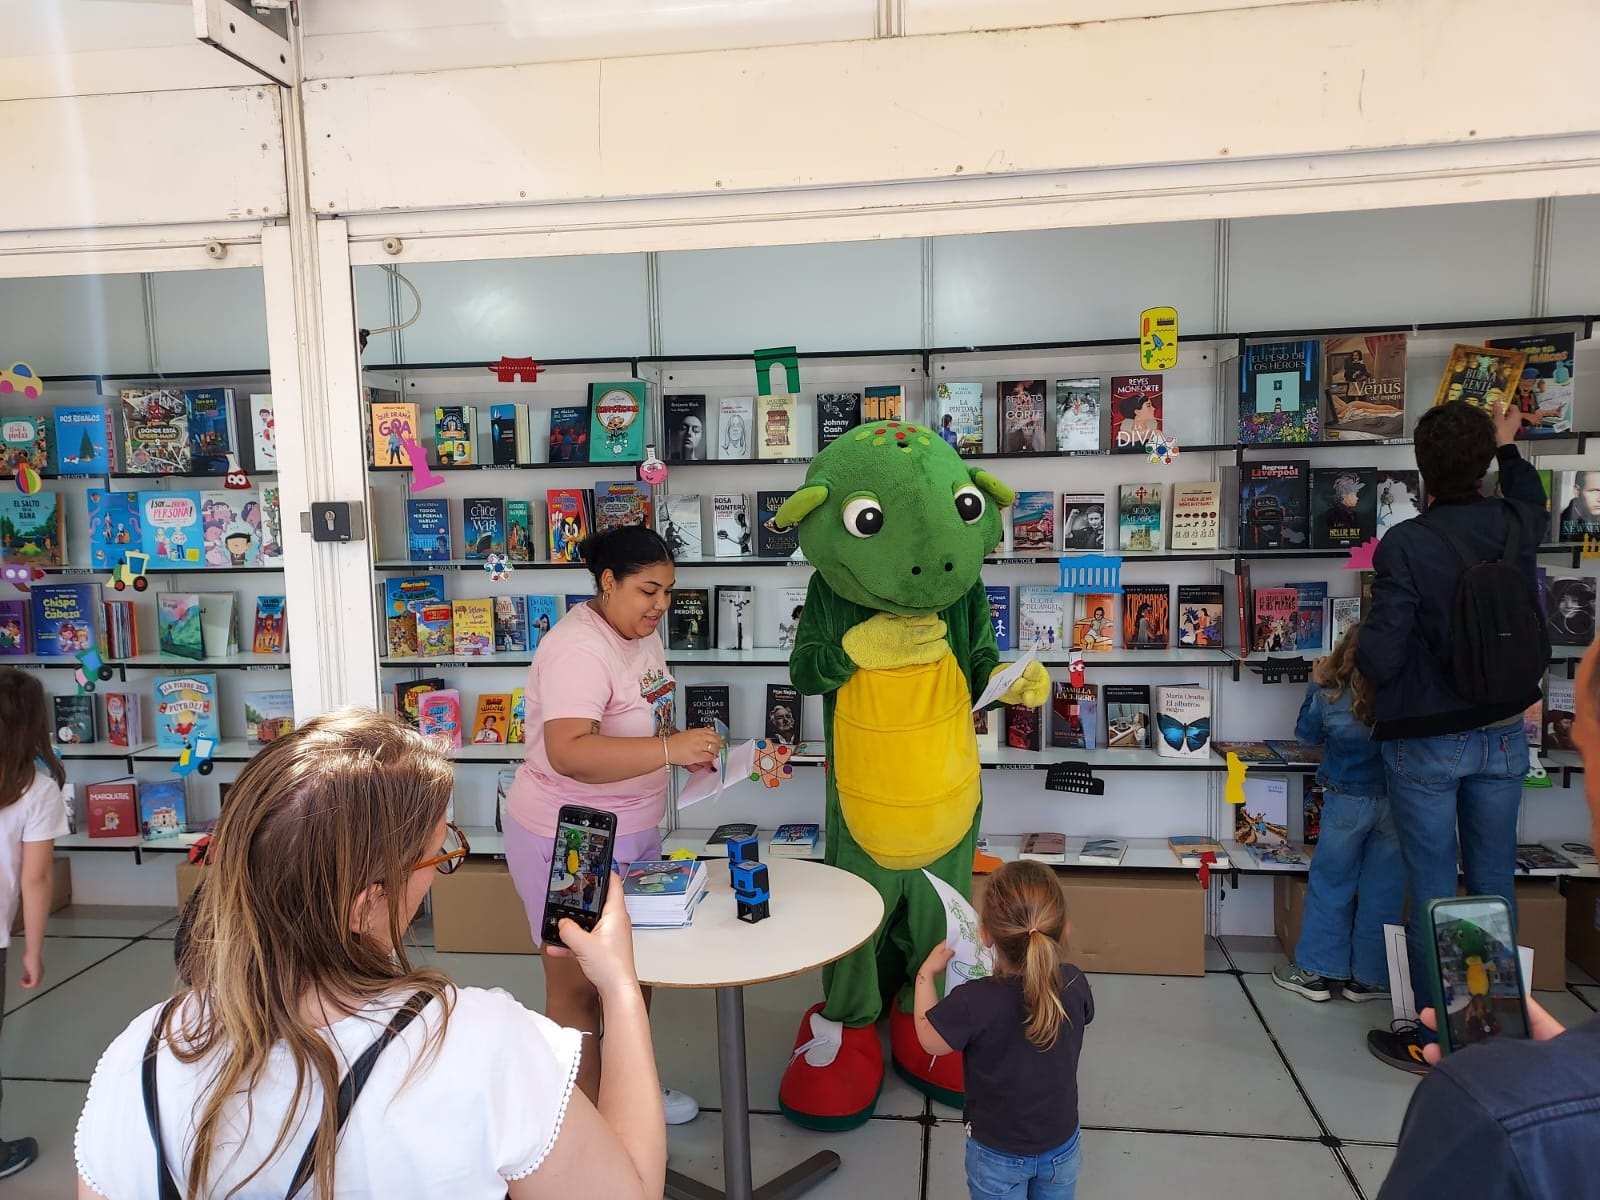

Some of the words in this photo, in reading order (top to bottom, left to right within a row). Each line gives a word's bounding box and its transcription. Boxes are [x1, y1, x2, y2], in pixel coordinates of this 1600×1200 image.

[1265, 352, 1290, 361] PESO
[1291, 352, 1304, 360] DE
[1250, 363, 1268, 372] LOS
[1128, 378, 1149, 386] REYES
[1118, 384, 1160, 394] MONFORTE
[1354, 382, 1400, 396] Venus
[1006, 394, 1042, 402] RETRATO
[73, 414, 100, 422] REGALOS
[1006, 410, 1043, 420] CORTE
[824, 419, 848, 427] Johnny
[1251, 468, 1298, 478] Liverpool
[472, 520, 498, 532] MAR
[1562, 524, 1600, 534] NEWMA
[43, 598, 76, 608] Chispa
[44, 610, 80, 619] Cabeza
[1060, 686, 1092, 695] CAMILLA
